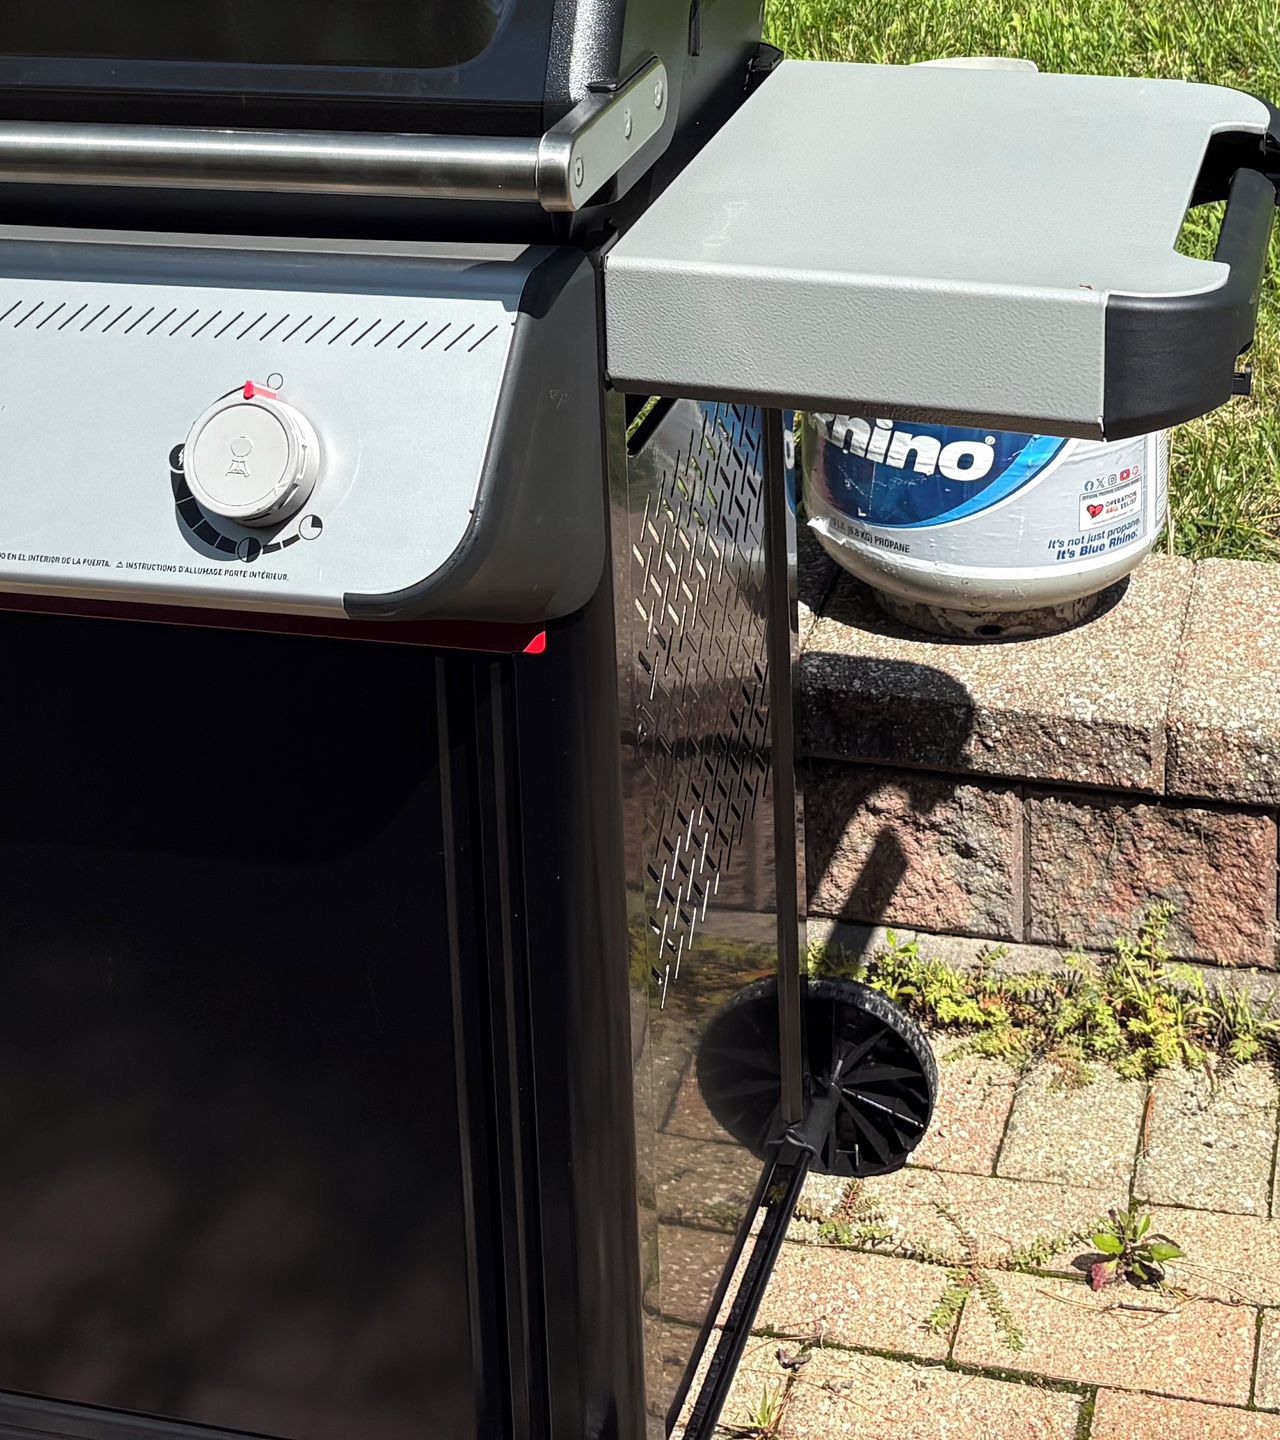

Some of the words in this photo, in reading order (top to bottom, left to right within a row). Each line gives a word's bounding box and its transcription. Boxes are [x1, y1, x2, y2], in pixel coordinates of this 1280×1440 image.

[874, 535, 910, 553] PROPANE
[1048, 539, 1065, 549] It's
[1067, 535, 1085, 547] not
[1086, 530, 1105, 544] just
[7, 552, 17, 561] EN
[18, 553, 26, 562] EL
[28, 554, 60, 564] INTERIOR
[61, 556, 71, 565] DE
[72, 557, 81, 566] LA
[1056, 548, 1076, 560] It's
[1079, 543, 1106, 556] Blue
[125, 562, 177, 573] INSTRUCTIONS
[178, 565, 223, 576] D'ALLUMAGE
[224, 569, 248, 578] PORTE
